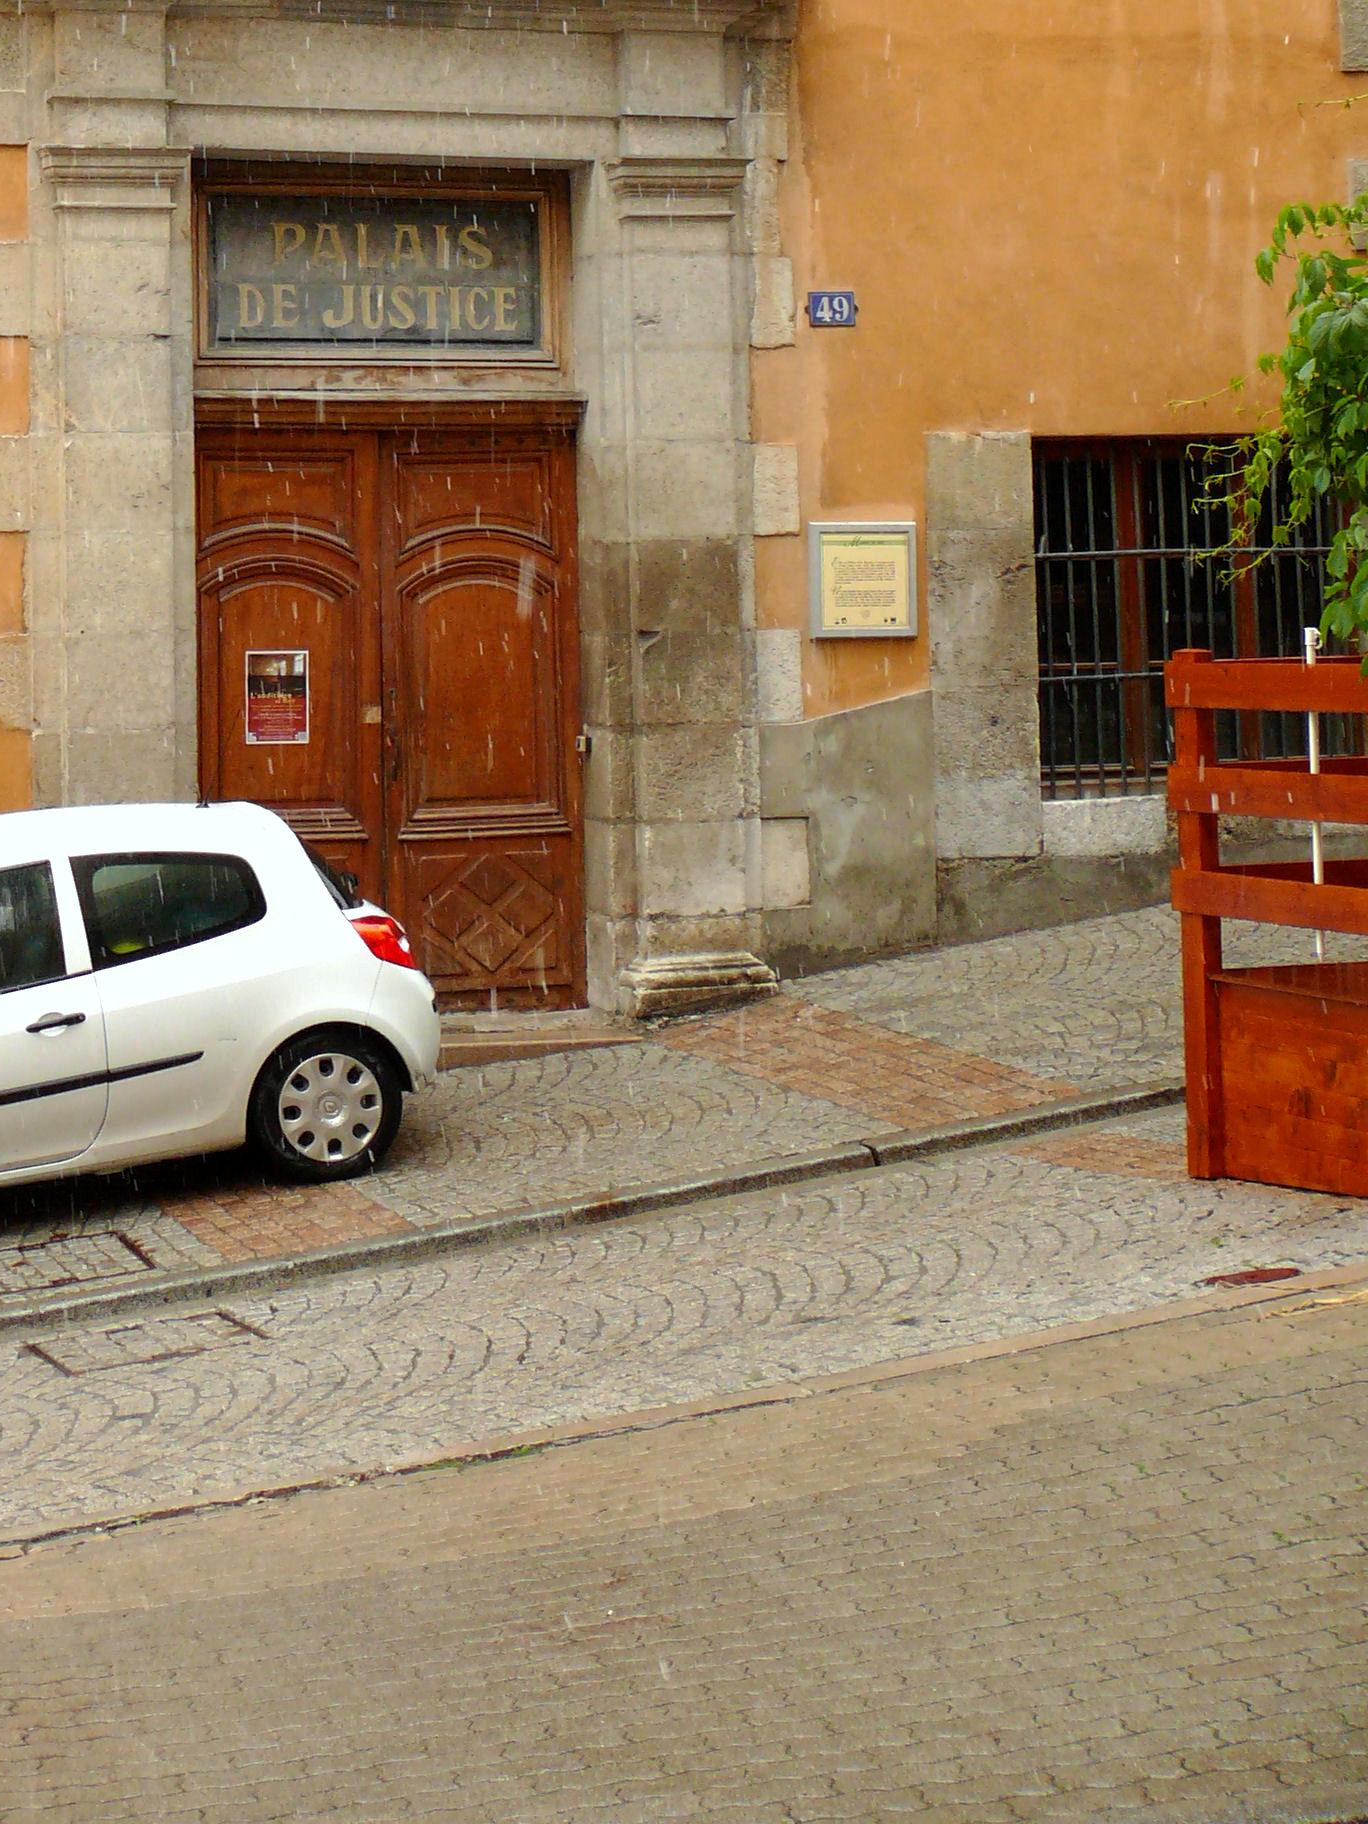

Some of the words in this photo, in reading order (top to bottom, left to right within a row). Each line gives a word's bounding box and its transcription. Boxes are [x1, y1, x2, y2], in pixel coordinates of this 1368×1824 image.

[272, 222, 493, 269] PALAIS
[237, 283, 301, 328] DE
[322, 285, 518, 331] JUSTICE
[815, 296, 850, 322] 49
